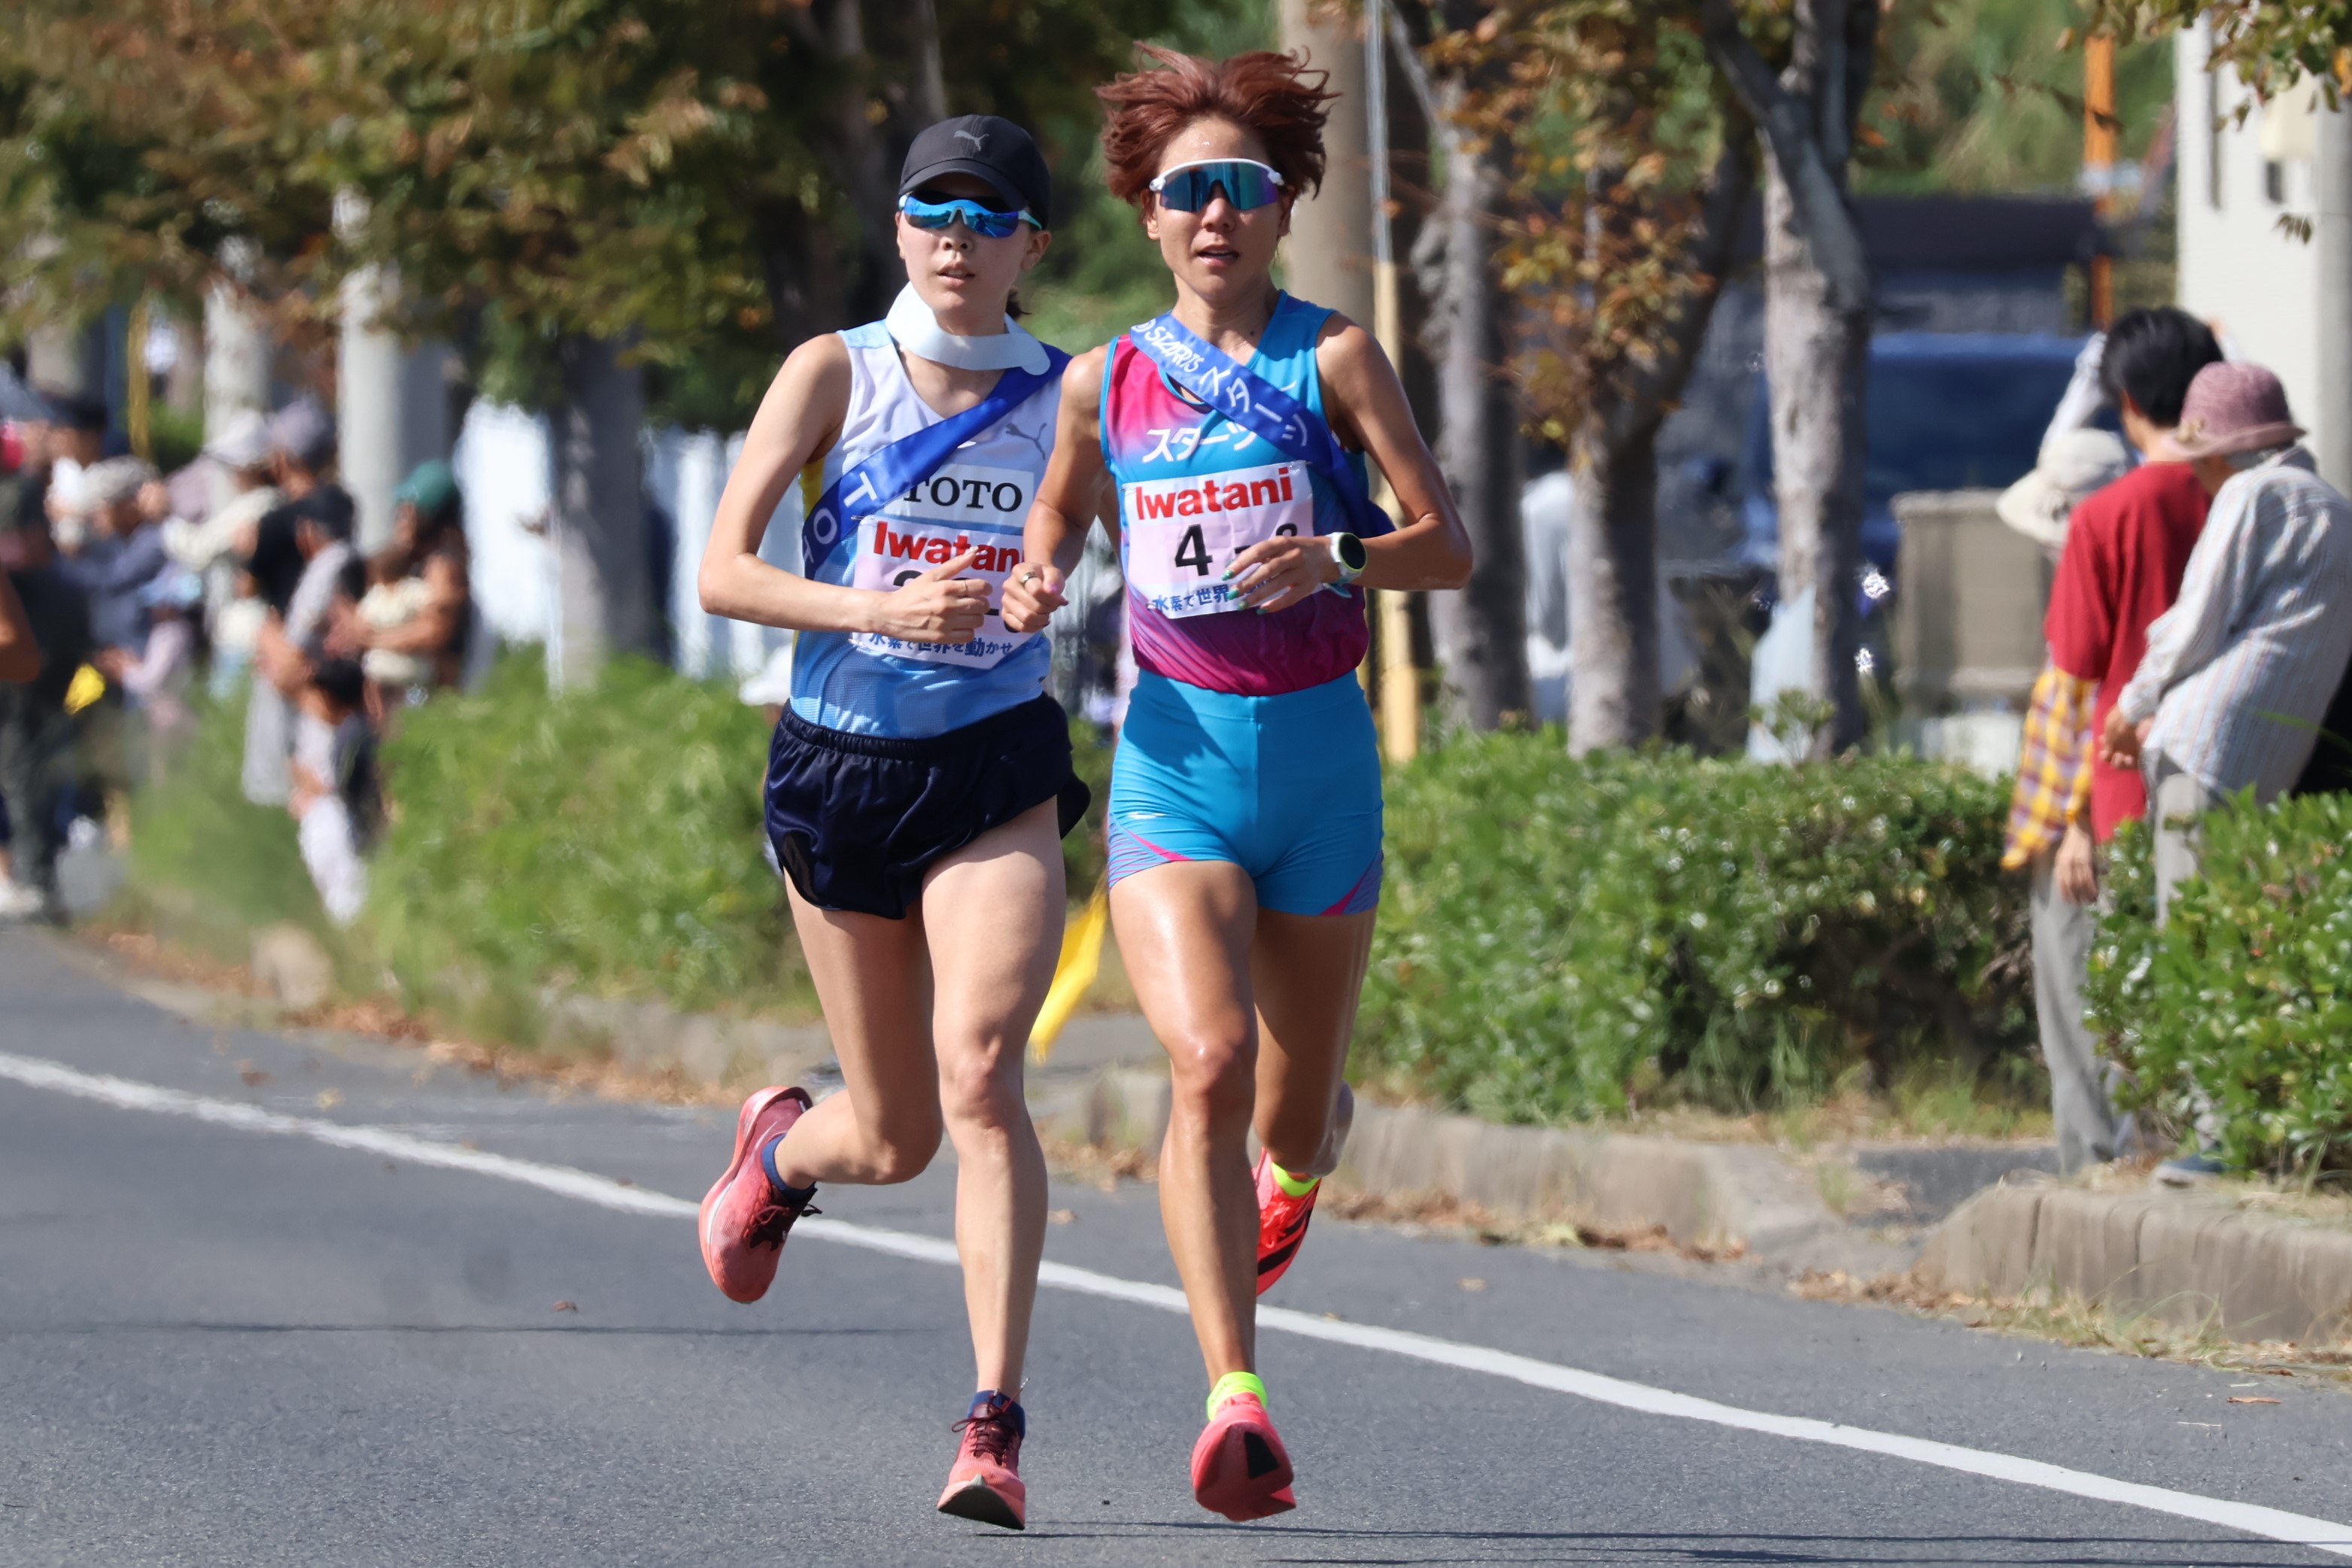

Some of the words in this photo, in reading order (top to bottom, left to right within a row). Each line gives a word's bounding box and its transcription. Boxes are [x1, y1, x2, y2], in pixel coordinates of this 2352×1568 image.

[1199, 366, 1308, 447] スターツ
[1141, 422, 1257, 463] スターツ
[903, 476, 1023, 512] TOTO
[1135, 466, 1293, 521] Iwatani
[873, 521, 1025, 573] Iwatan
